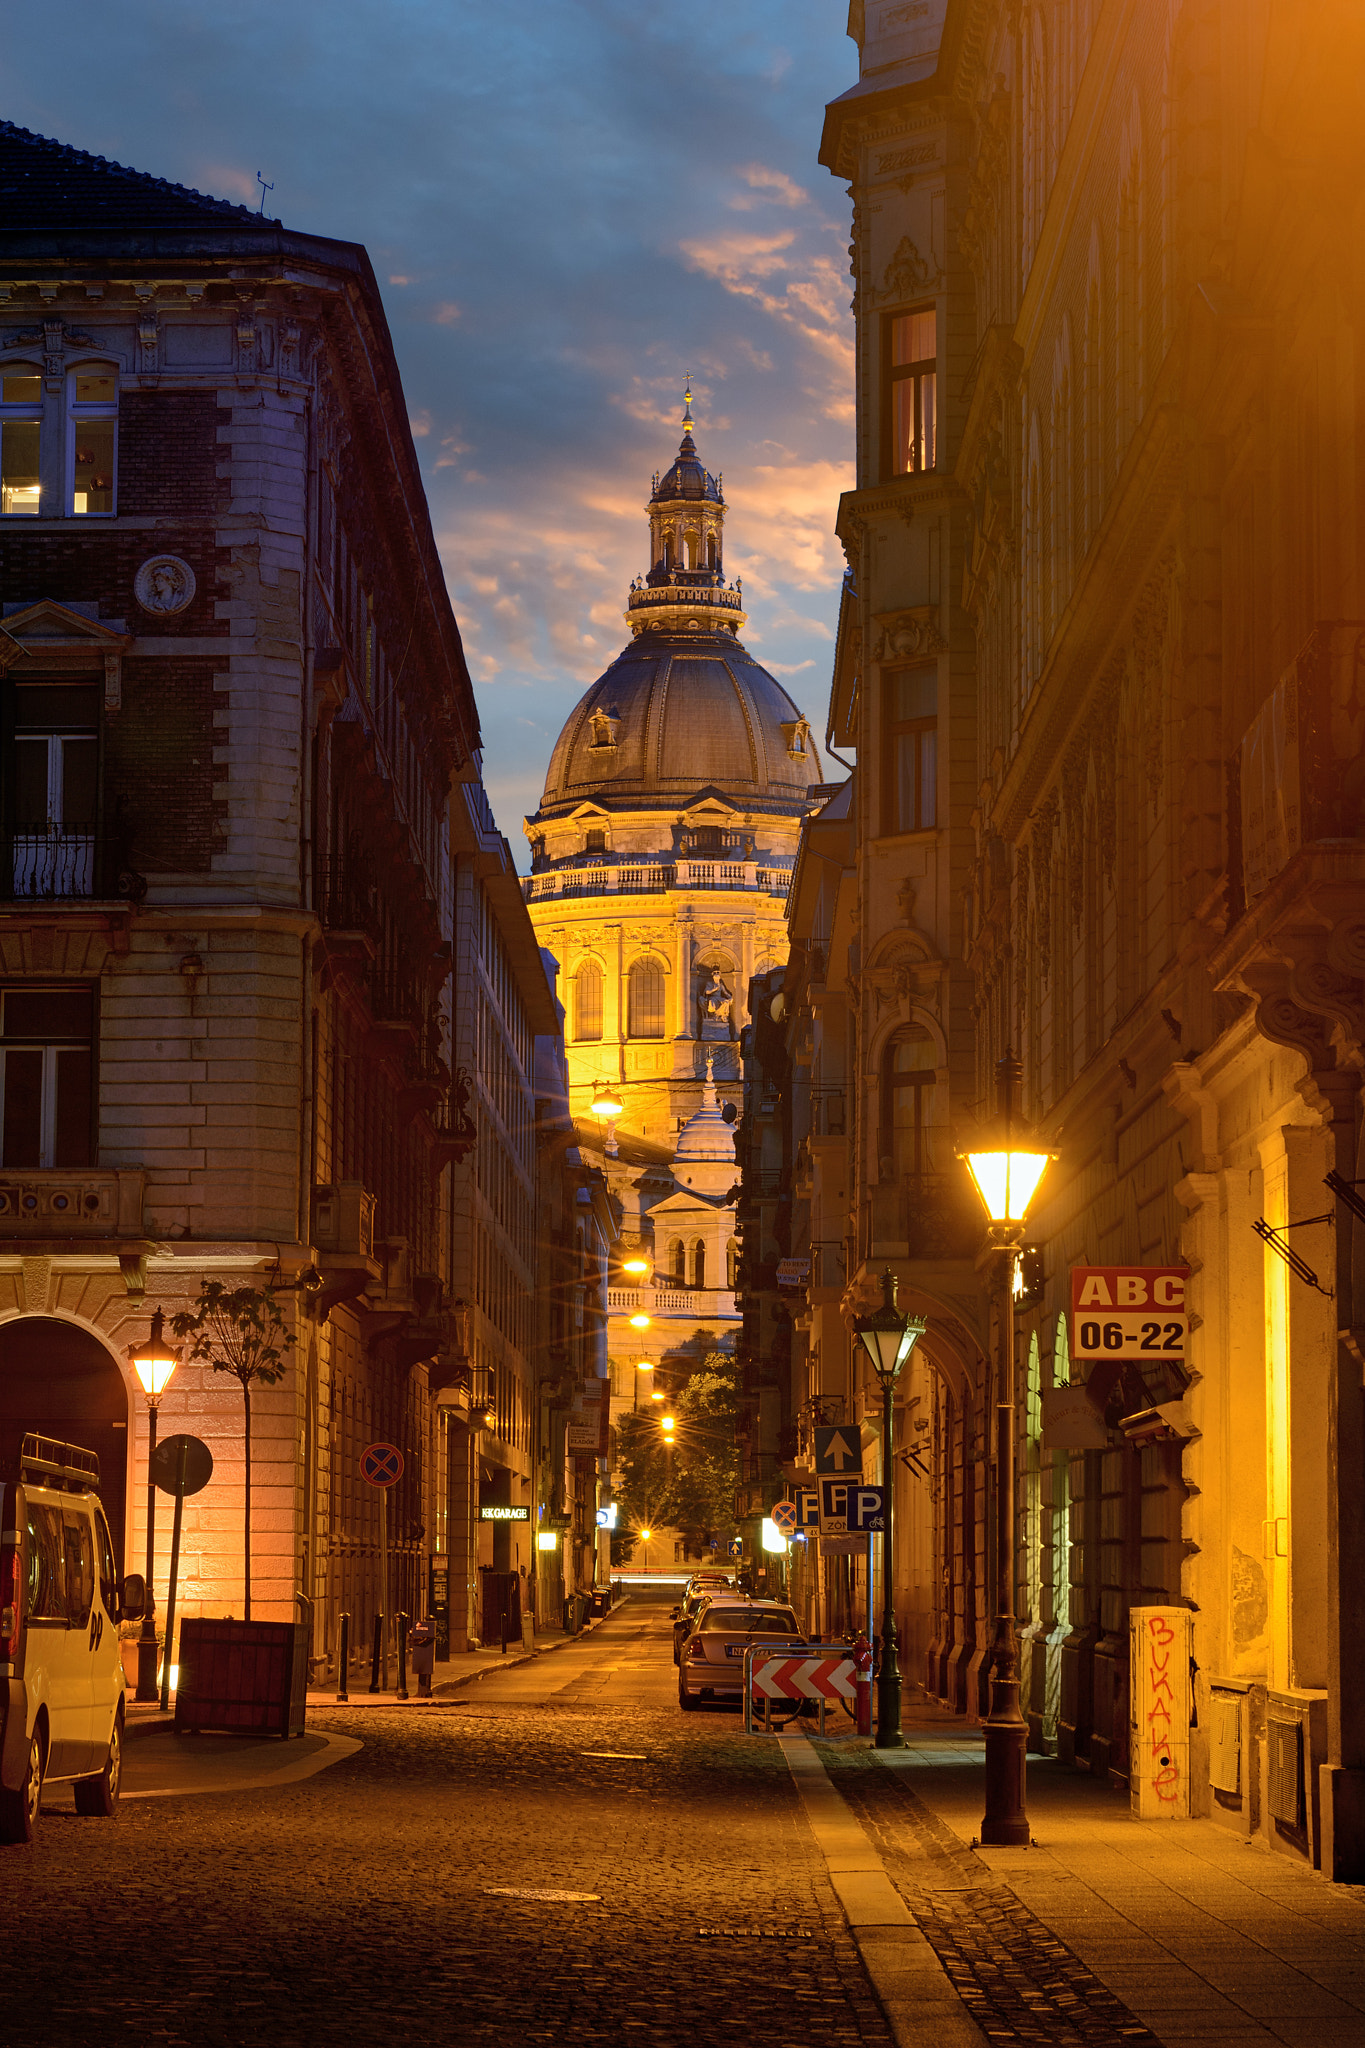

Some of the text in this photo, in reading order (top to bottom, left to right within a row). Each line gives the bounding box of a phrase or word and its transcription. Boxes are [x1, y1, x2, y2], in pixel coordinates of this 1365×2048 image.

[1078, 1275, 1185, 1307] ABC
[1080, 1321, 1184, 1351] 06-22
[494, 1508, 528, 1519] GARAGE
[857, 1492, 882, 1527] P
